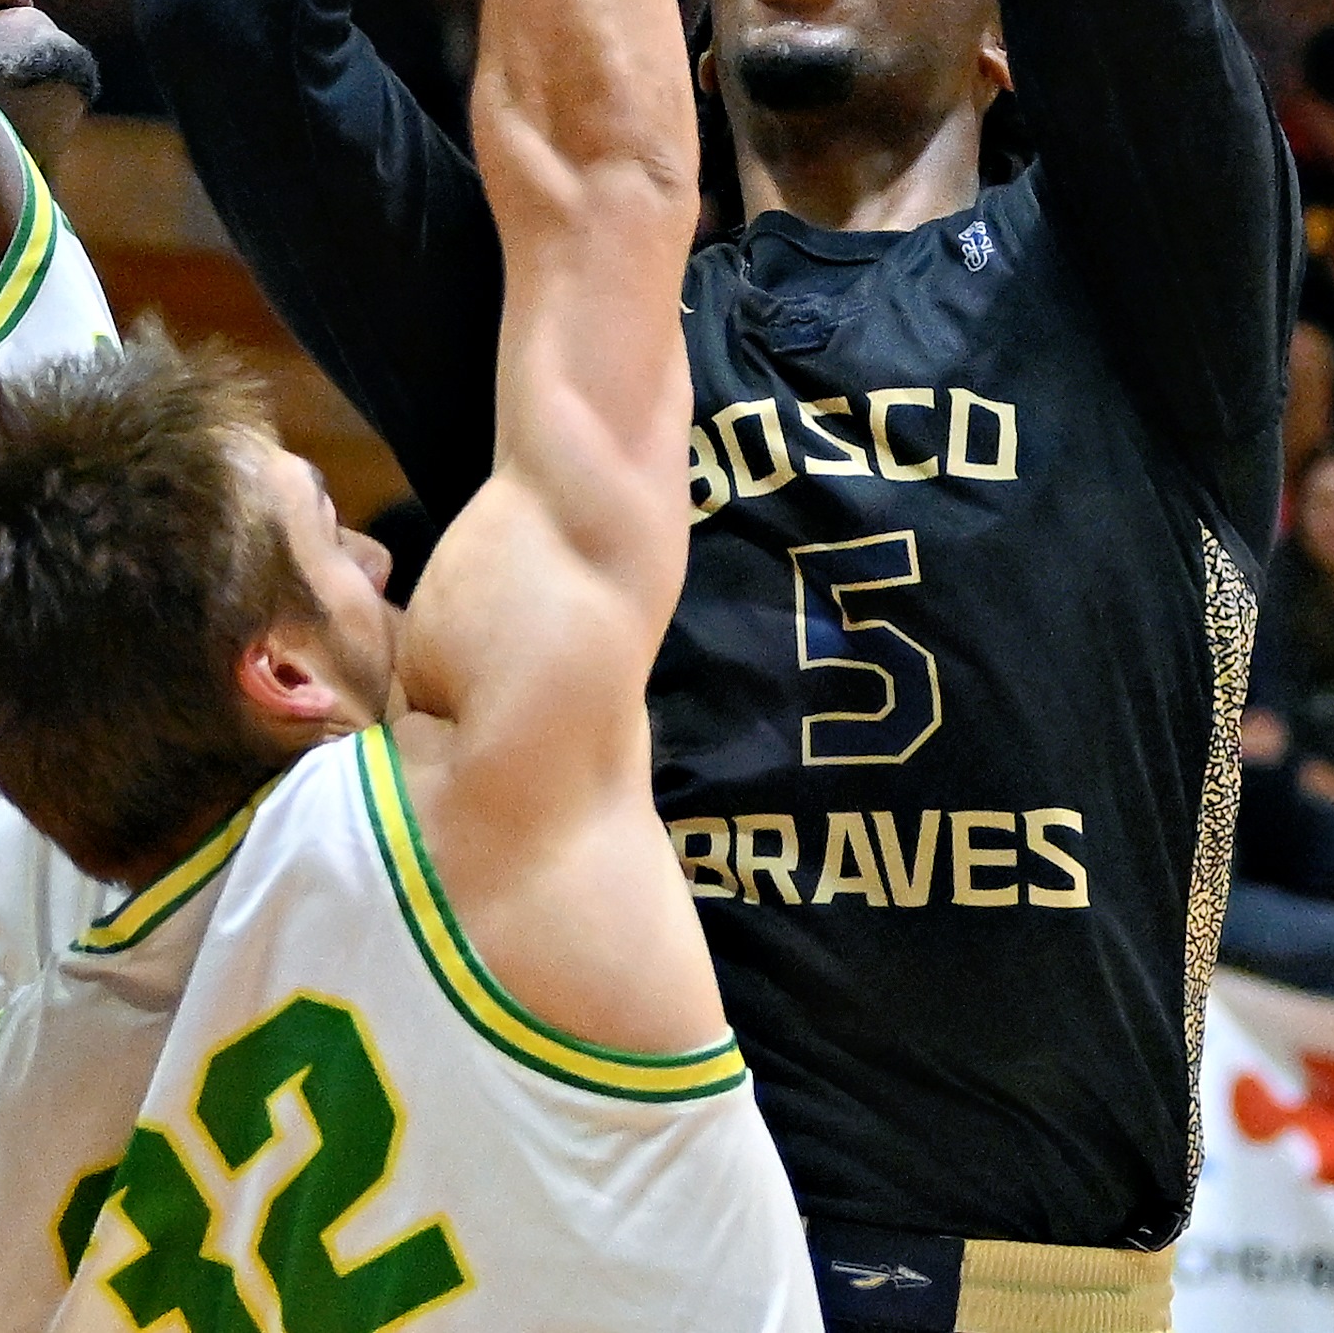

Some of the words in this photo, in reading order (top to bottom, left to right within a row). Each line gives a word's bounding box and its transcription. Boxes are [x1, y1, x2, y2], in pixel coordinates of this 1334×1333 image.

[689, 387, 1018, 526] BOSCO
[788, 529, 942, 767] 5
[667, 807, 1091, 909] BRAVES
[50, 988, 477, 1333] 32
